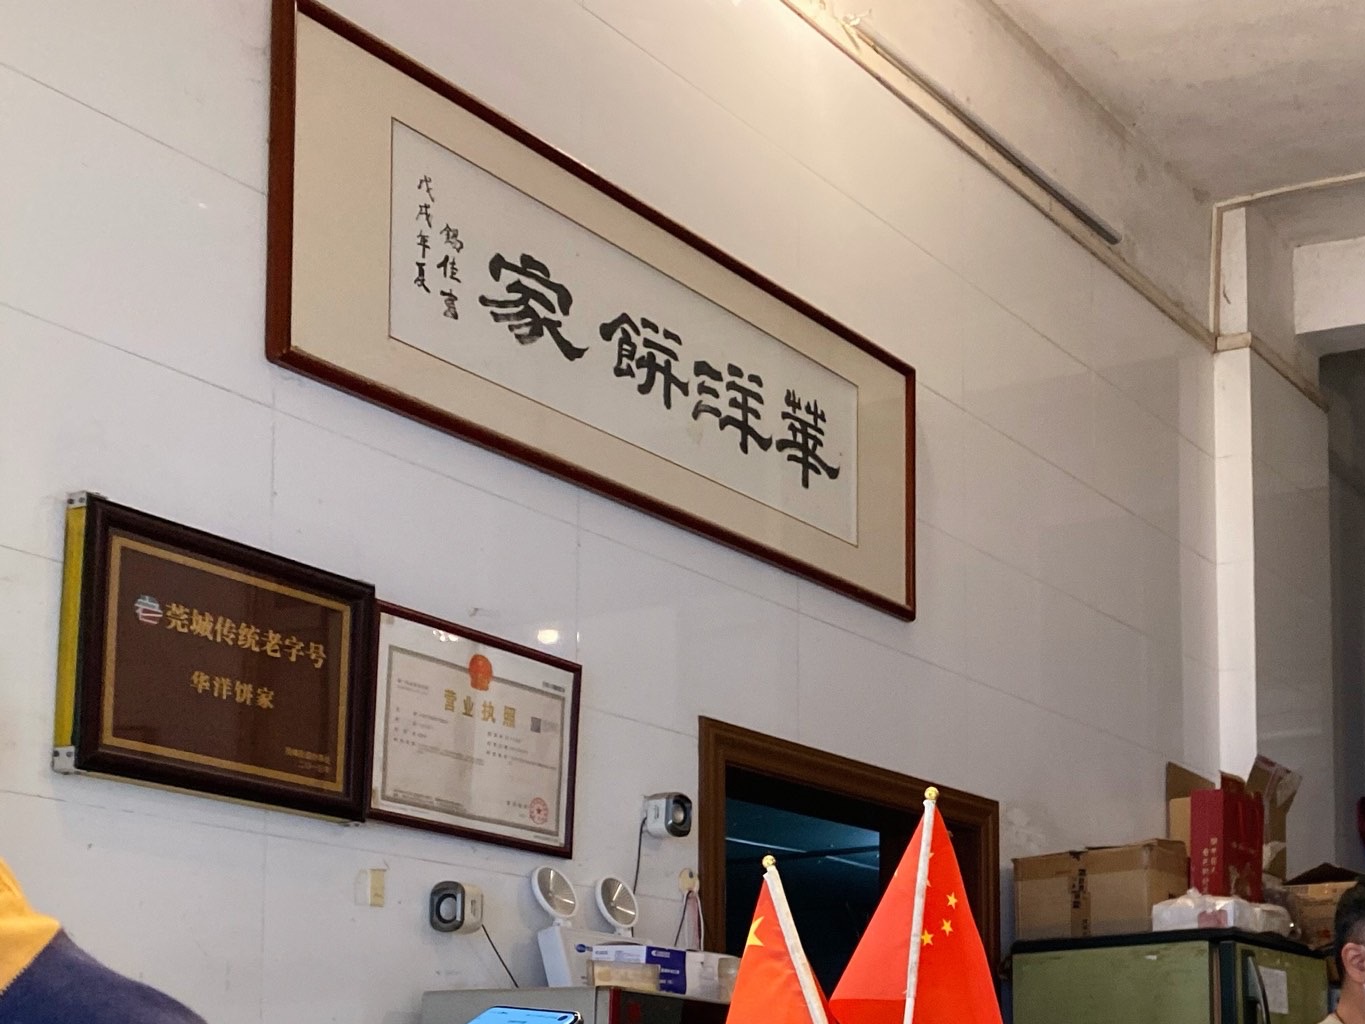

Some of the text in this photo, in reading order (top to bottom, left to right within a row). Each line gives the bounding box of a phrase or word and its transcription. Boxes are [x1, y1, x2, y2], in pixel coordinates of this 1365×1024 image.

[165, 602, 327, 669] 莞城传统老字号
[190, 670, 276, 710] 华洋饼家
[443, 689, 517, 729] 营业执照
